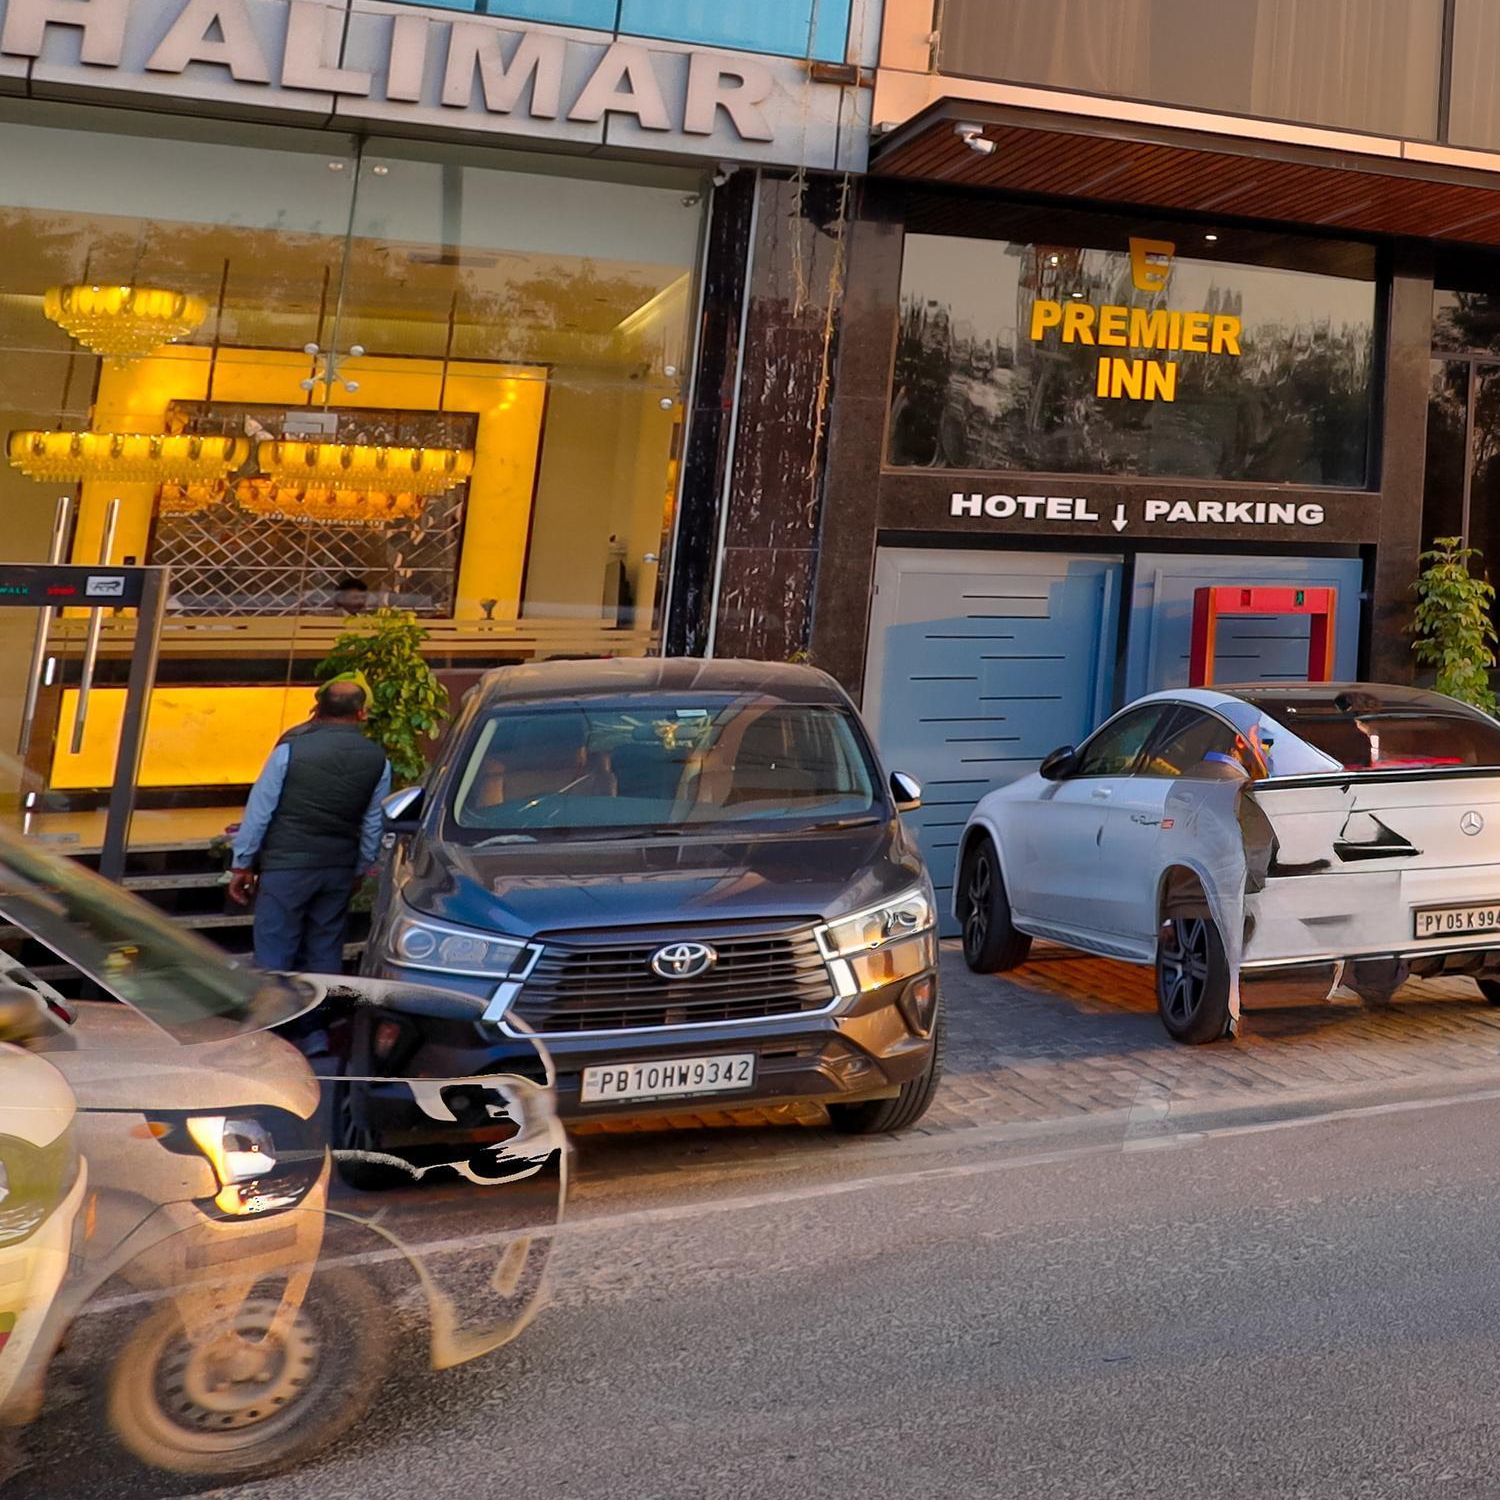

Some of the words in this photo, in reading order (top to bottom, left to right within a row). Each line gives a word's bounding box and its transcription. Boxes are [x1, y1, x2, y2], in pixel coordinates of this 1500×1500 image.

[1030, 299, 1241, 355] PREMIER
[1096, 357, 1176, 402] INN
[950, 493, 1099, 521] HOTEL
[1144, 500, 1325, 525] PARKING
[1425, 914, 1443, 932] PY
[1446, 913, 1463, 930] 05
[1467, 912, 1476, 928] K
[600, 1060, 751, 1094] PB10HW9342
